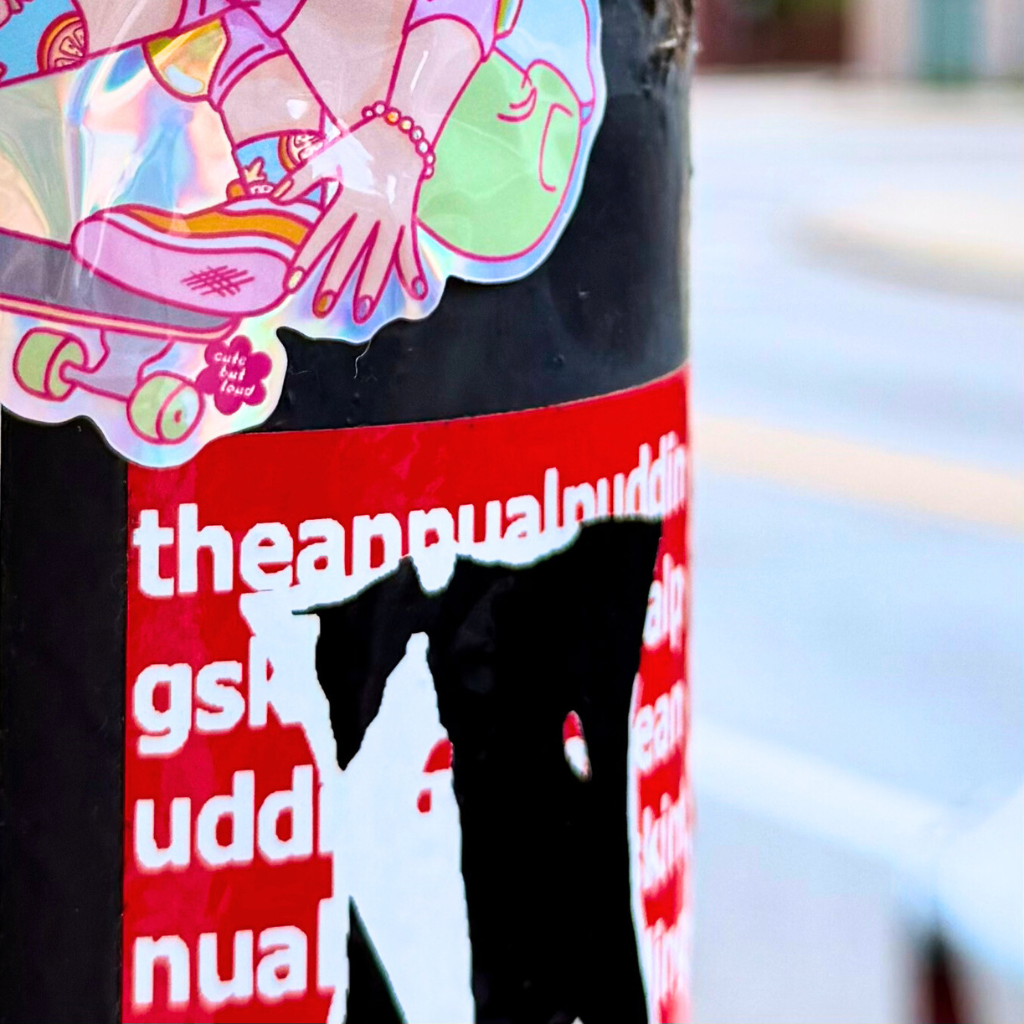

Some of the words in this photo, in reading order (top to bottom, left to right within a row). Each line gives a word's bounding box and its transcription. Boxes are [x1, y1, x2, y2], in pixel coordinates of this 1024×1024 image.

[214, 351, 247, 366] cute
[219, 365, 246, 381] but
[220, 379, 256, 397] loud
